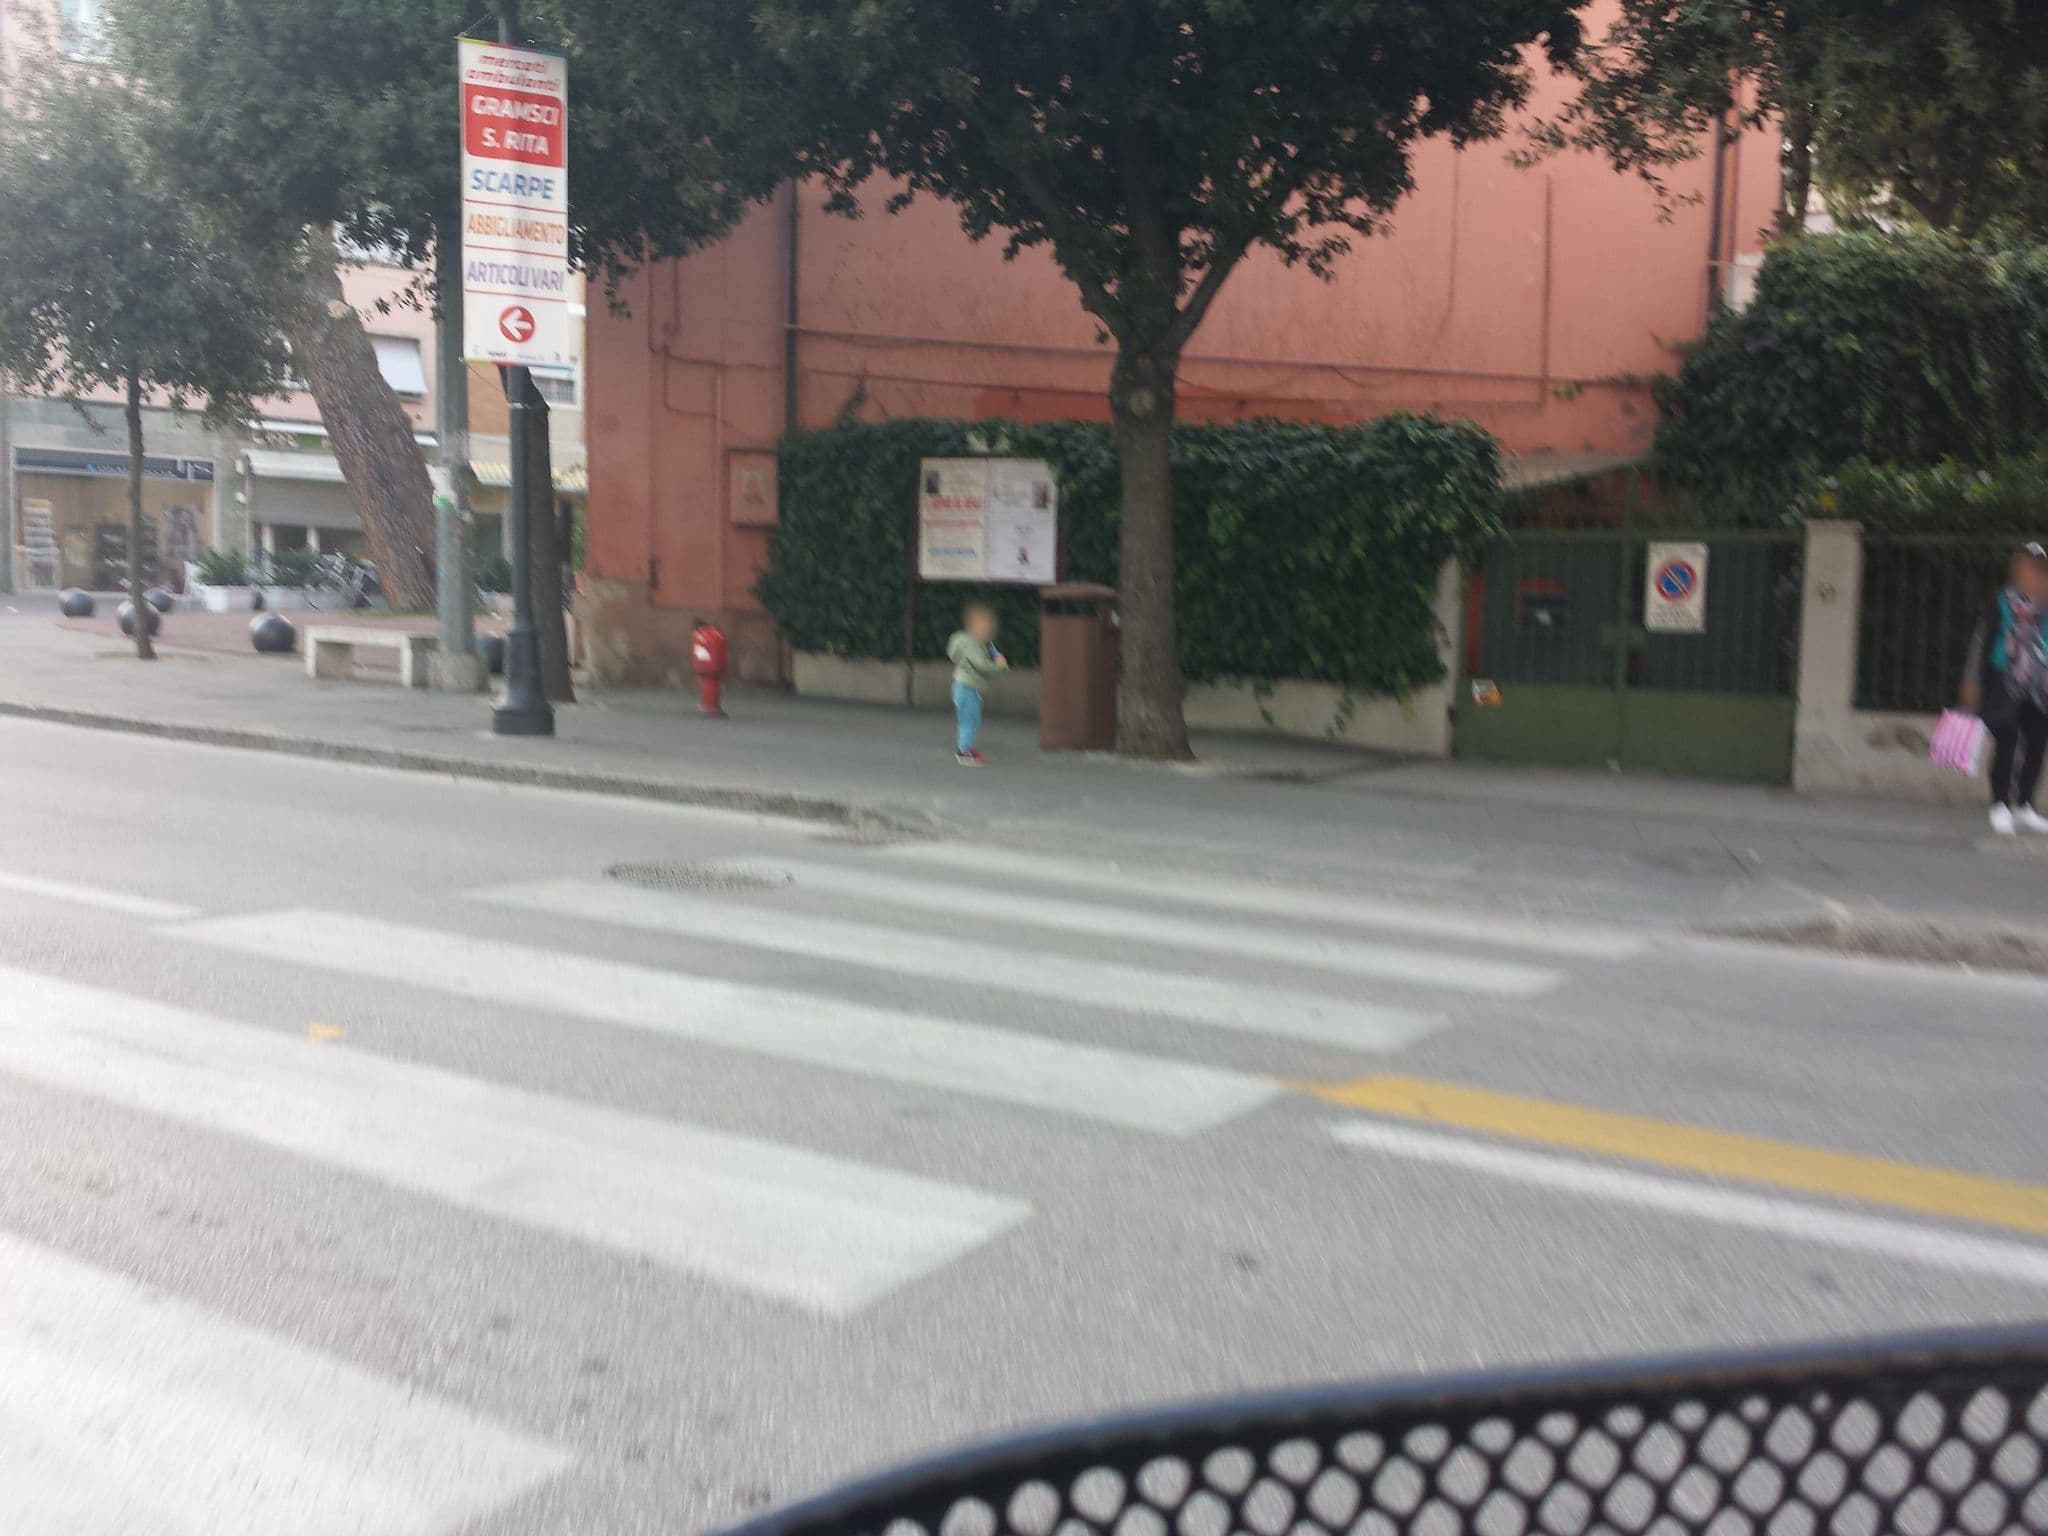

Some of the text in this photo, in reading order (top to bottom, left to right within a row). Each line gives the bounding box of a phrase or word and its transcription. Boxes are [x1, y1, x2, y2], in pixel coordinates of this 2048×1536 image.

[466, 68, 560, 92] ambulanti
[471, 95, 560, 126] GRAMSCI
[481, 127, 549, 156] S. RITA
[471, 168, 555, 200] SCARPE
[468, 212, 564, 245] ABBIGLIAMENTO
[467, 261, 564, 292] ARTICOLI VARI
